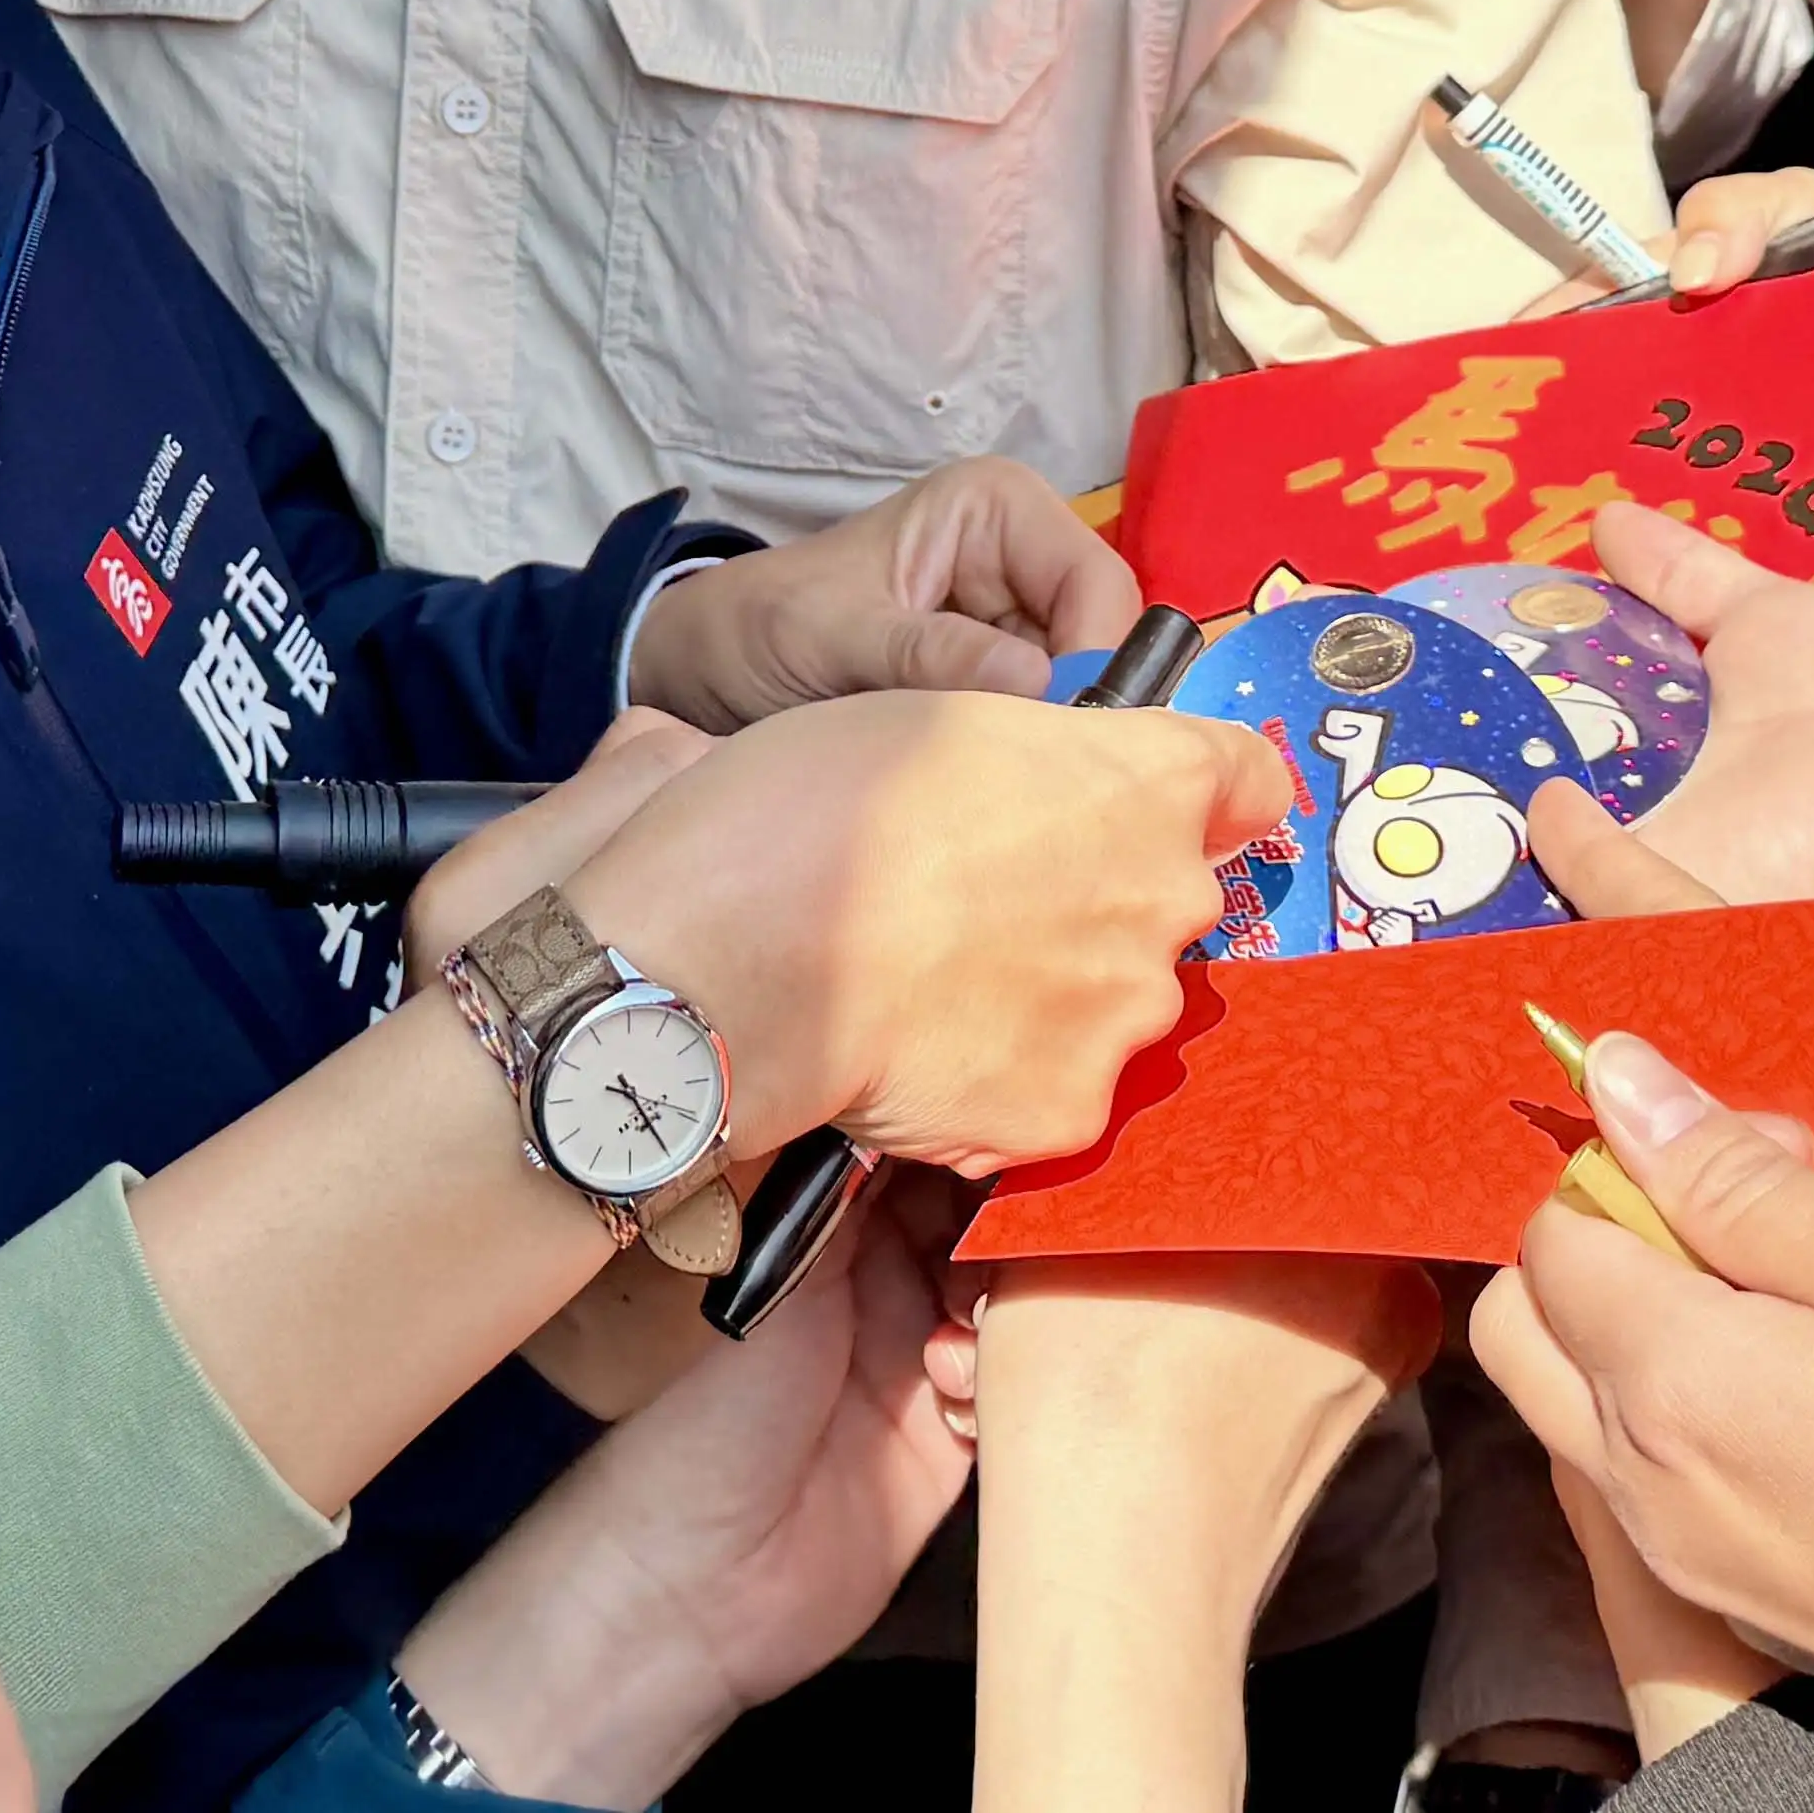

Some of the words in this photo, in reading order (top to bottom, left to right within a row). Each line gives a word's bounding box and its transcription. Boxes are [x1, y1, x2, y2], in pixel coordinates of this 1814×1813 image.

[126, 433, 183, 541] KAOHSIUNG
[145, 515, 169, 560] CITY
[160, 473, 215, 580] GOVERNMENT
[224, 546, 338, 717] 市長
